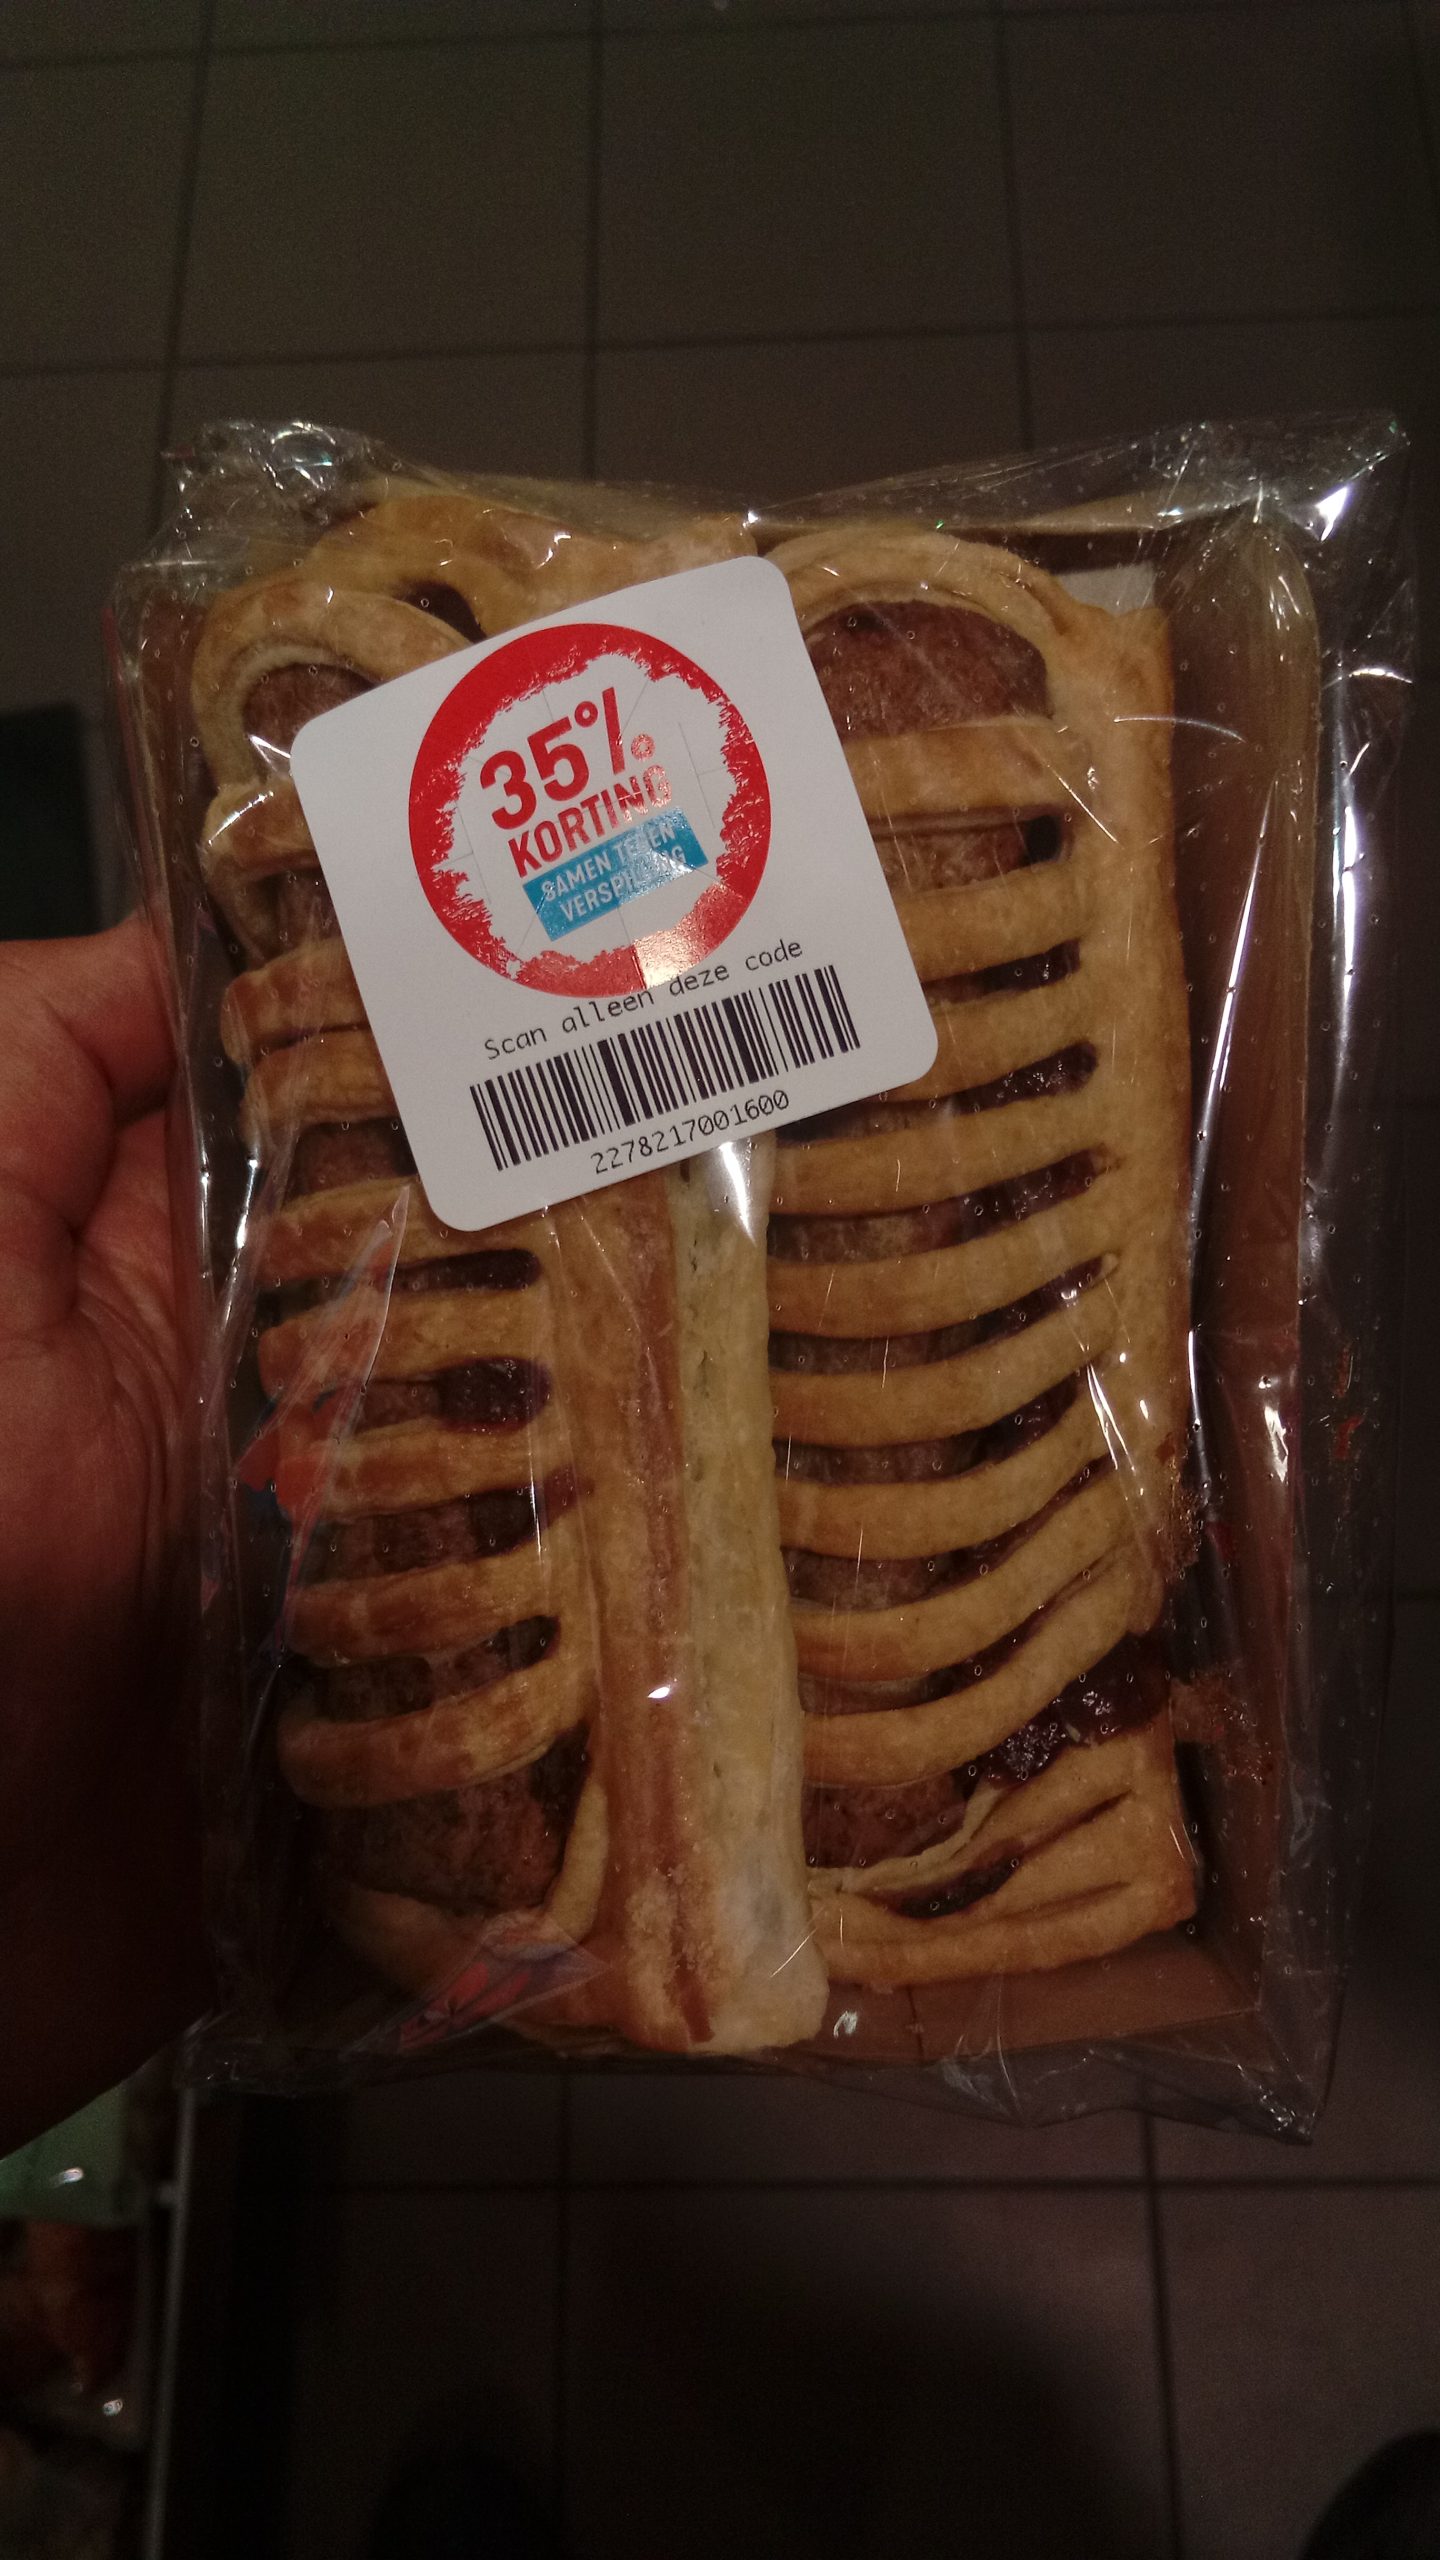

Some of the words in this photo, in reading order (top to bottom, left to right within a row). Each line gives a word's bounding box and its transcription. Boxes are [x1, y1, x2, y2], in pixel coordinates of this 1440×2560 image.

[480, 686, 656, 830] 35%
[508, 764, 673, 878] KORTING
[541, 852, 612, 902] SAMEN
[484, 1025, 547, 1060] Scan
[561, 988, 655, 1034] alleen
[668, 962, 730, 997] deze
[744, 938, 804, 972] code
[590, 1089, 790, 1175] 2278217001600
